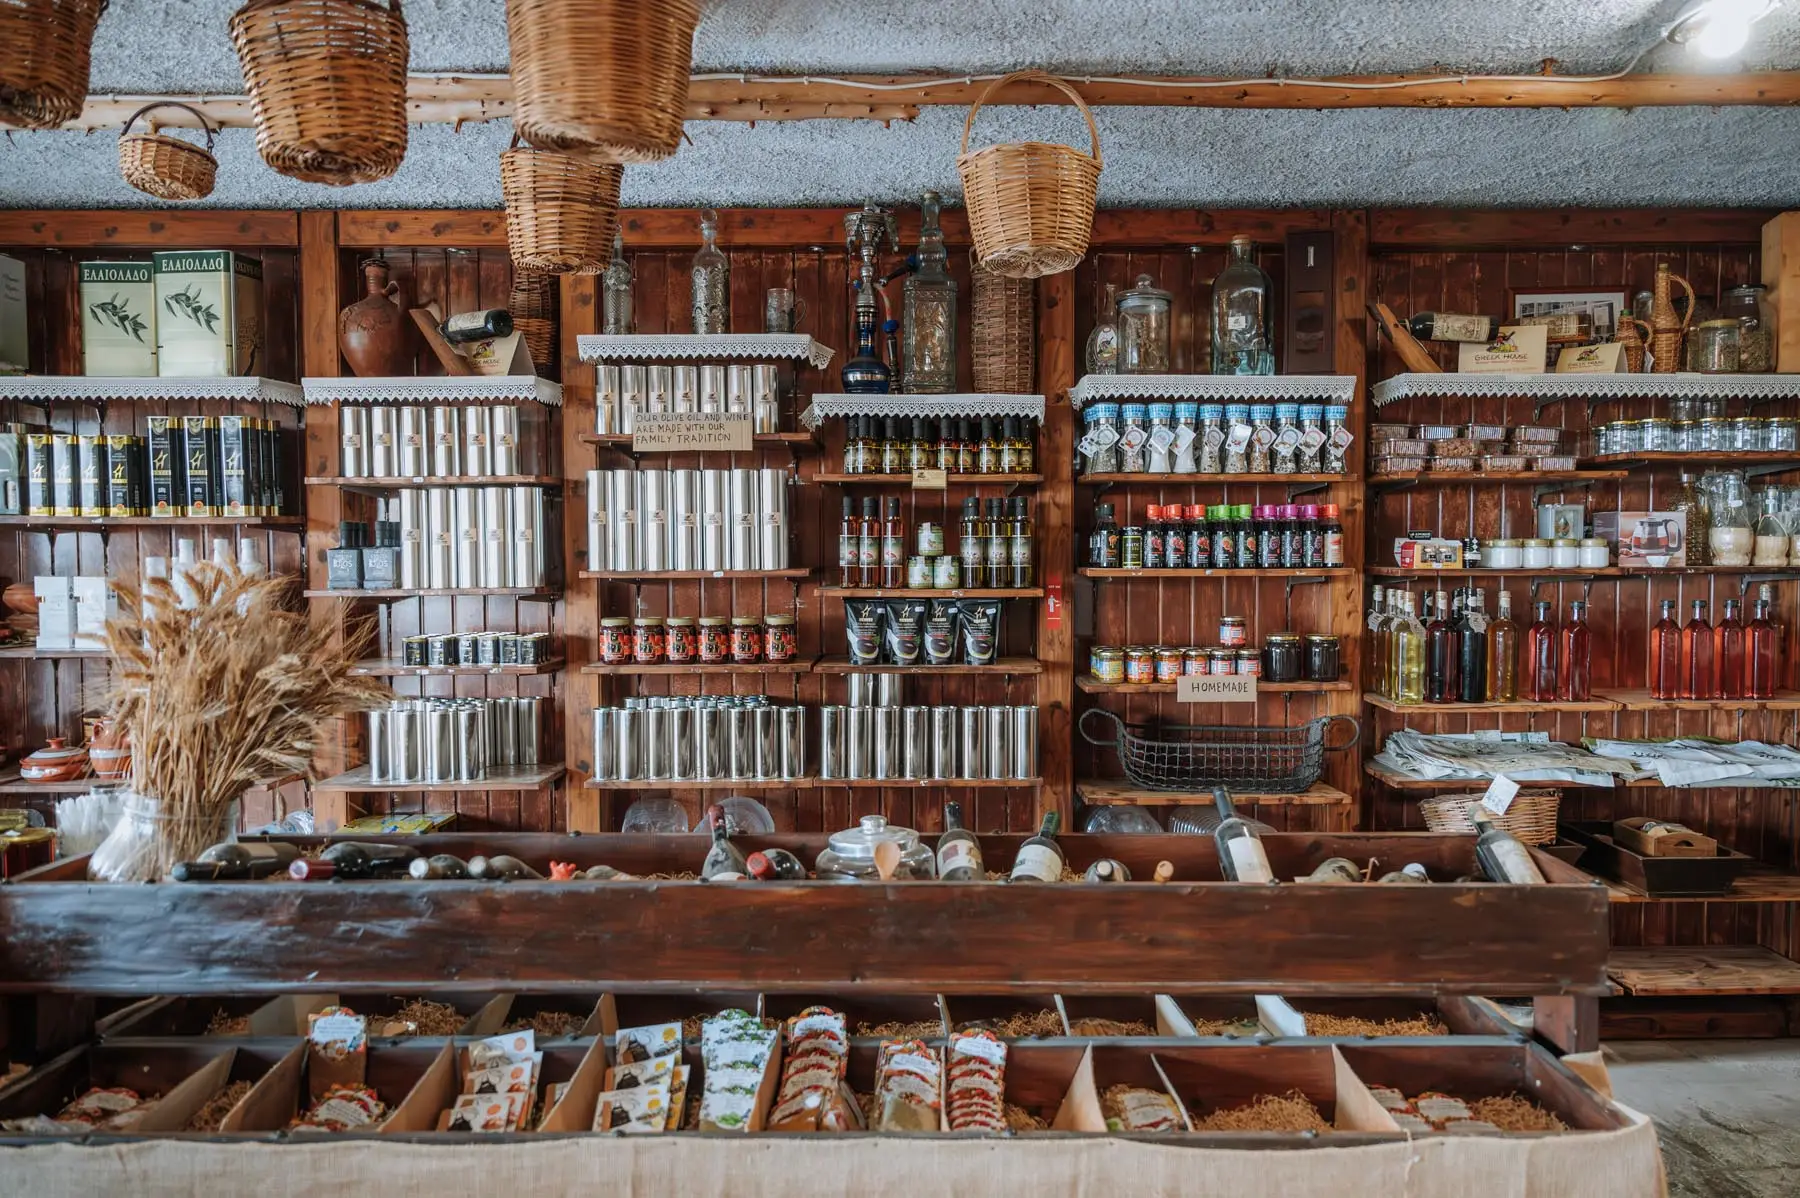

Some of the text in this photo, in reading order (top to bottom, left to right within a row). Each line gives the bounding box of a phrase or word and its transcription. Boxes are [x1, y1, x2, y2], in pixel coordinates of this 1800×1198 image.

[162, 258, 224, 271] ΕΛΑΙΟΛΑΔΟ
[83, 269, 148, 281] ΕΛΑΙΟΛΑΔΟ
[636, 414, 657, 422] OUR
[661, 414, 684, 422] OLIVE
[704, 414, 720, 422] AND
[724, 413, 749, 421] WINE
[636, 423, 725, 433] ARE MADE WITH OUR
[636, 433, 731, 444] FAMILY TRADITION
[1191, 682, 1249, 693] HOMEMADE
